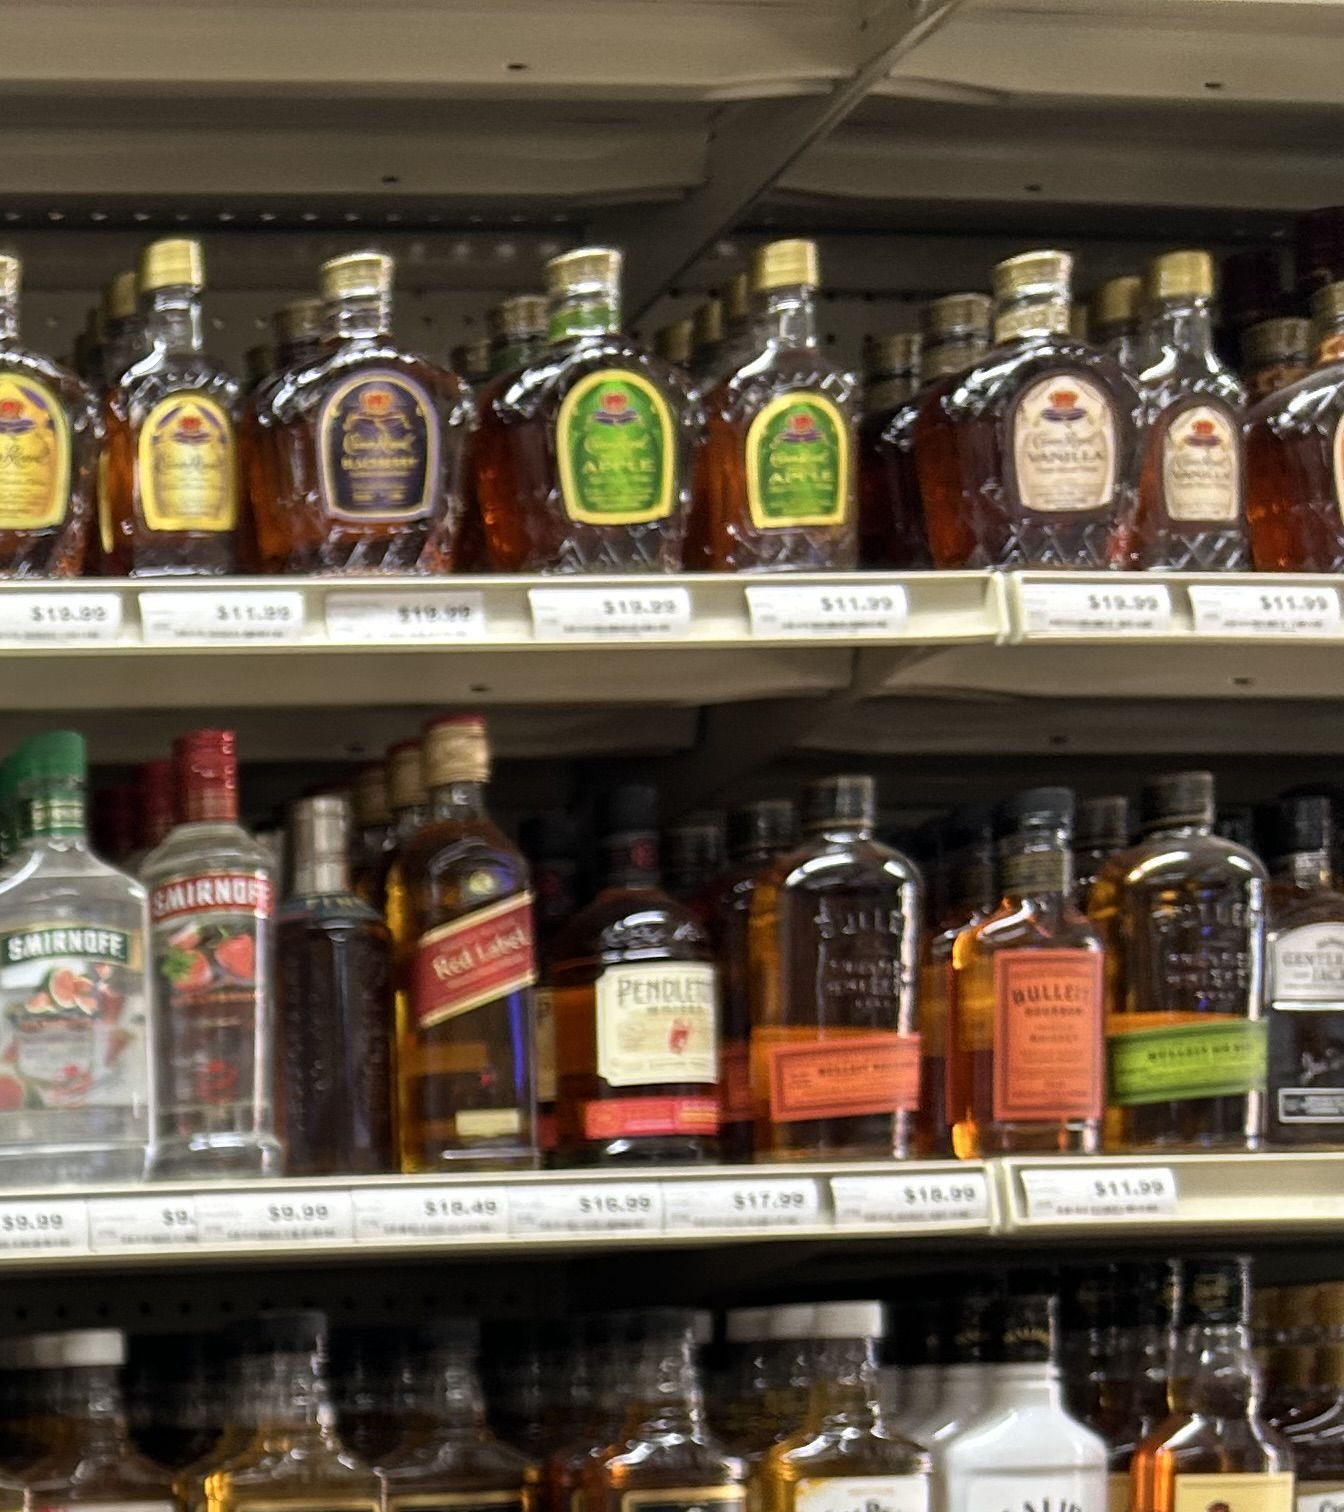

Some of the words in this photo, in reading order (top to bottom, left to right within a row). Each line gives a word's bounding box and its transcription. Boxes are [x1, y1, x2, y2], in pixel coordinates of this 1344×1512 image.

[8, 931, 126, 961] SMIRNOFF
[432, 950, 473, 982] Red
[474, 927, 531, 963] Label
[617, 976, 713, 1008] PENDLET
[2, 1214, 64, 1232] $9.99
